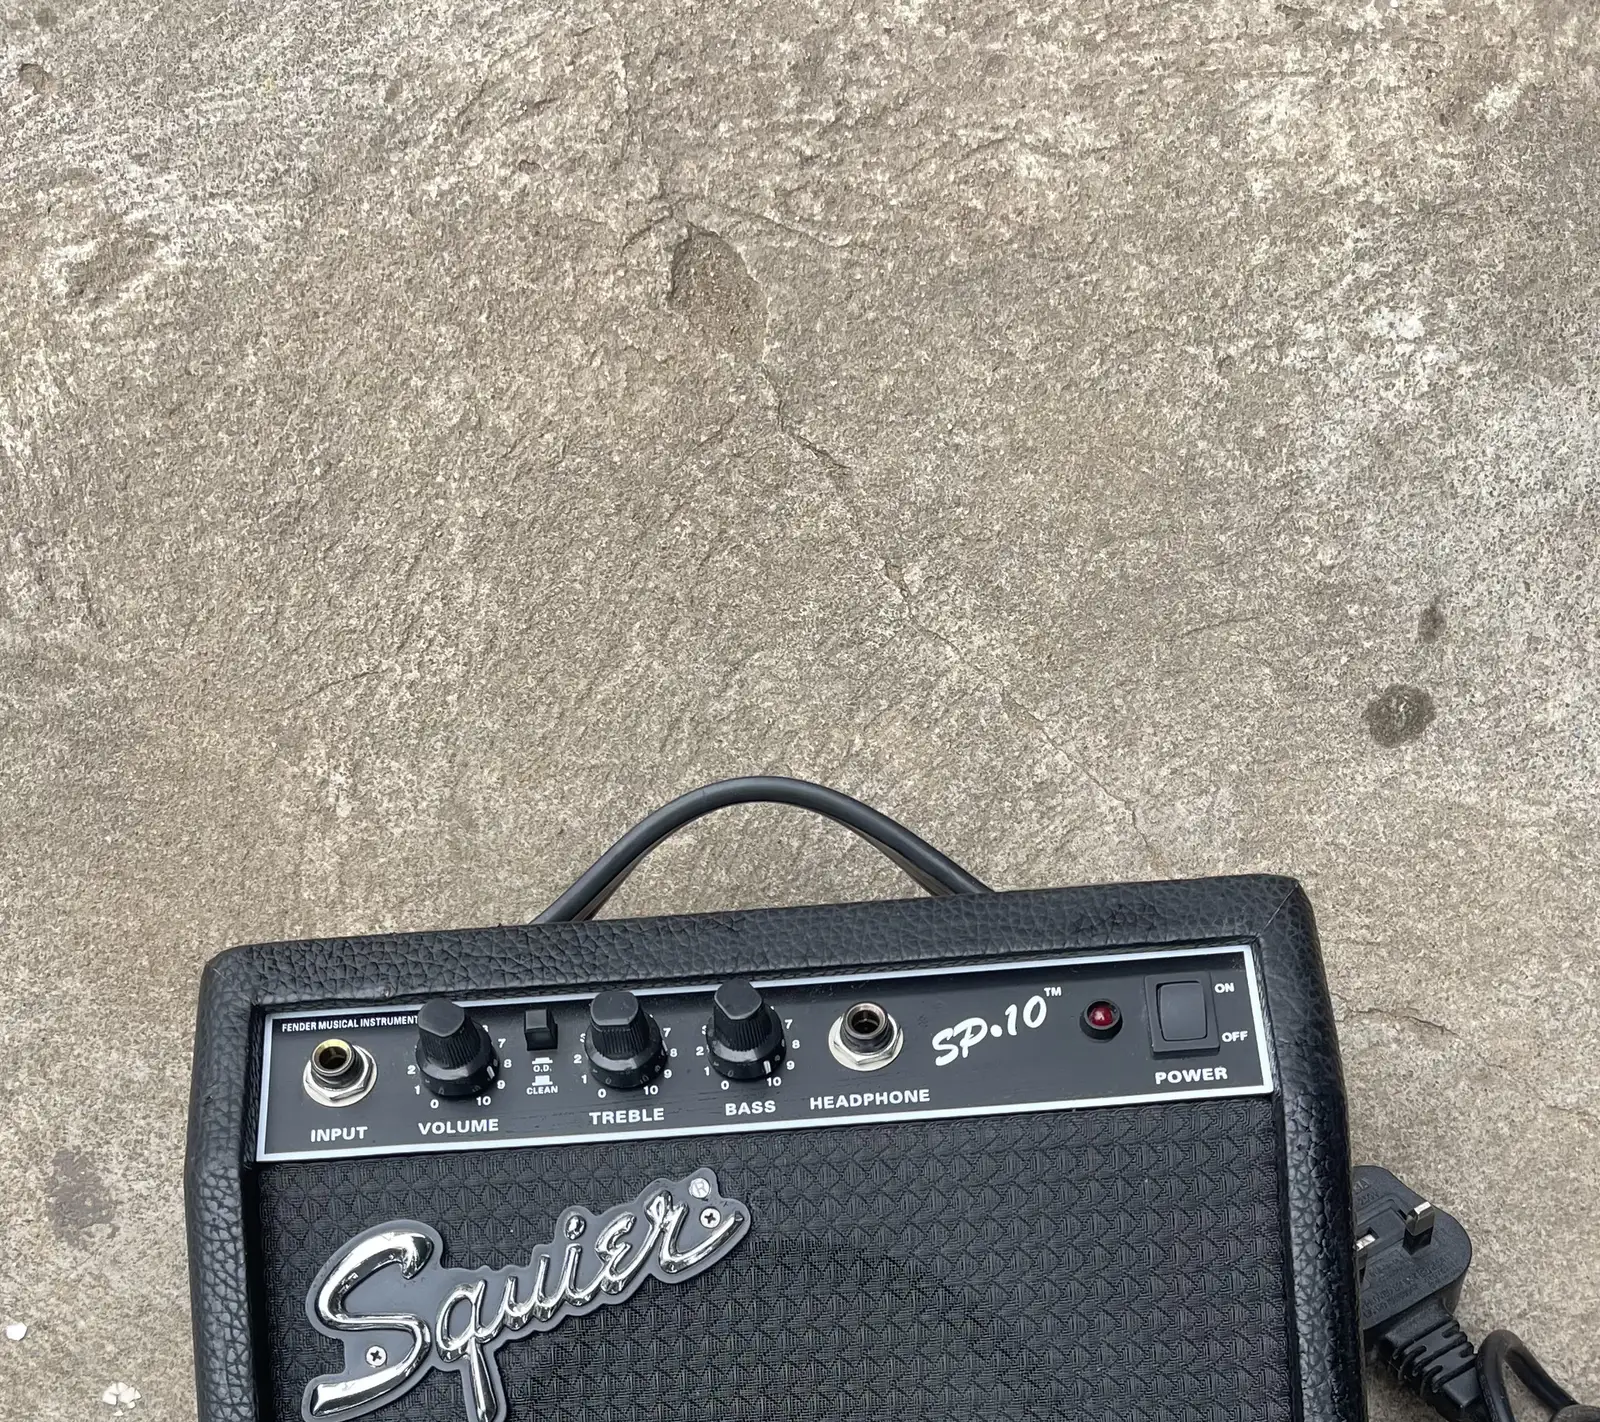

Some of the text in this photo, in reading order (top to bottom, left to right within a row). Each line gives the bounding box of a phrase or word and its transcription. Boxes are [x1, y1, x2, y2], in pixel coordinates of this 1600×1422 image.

[1214, 982, 1235, 994] ON
[281, 1021, 317, 1033] FENDER
[318, 1018, 359, 1030] MUSICAL
[784, 1018, 793, 1030] 7
[662, 1027, 672, 1038] 7
[1221, 1030, 1248, 1043] OFF
[497, 1037, 507, 1049] 7
[791, 1039, 801, 1049] 8
[669, 1047, 678, 1058] 8
[695, 1045, 705, 1057] 2
[503, 1058, 512, 1069] 8
[573, 1053, 582, 1064] 2
[407, 1064, 416, 1075] 2
[703, 1066, 710, 1076] 1
[786, 1060, 795, 1071] 9
[581, 1074, 587, 1084] 1
[663, 1068, 673, 1079] 9
[1154, 1066, 1228, 1085] POWER
[496, 1079, 506, 1090] 9
[720, 1080, 730, 1091] 0
[766, 1076, 782, 1087] 10
[414, 1084, 421, 1095] 1
[526, 1086, 559, 1095] CLEAN
[597, 1088, 607, 1099] 0
[643, 1085, 659, 1096] 10
[429, 1098, 440, 1109] 0
[476, 1095, 492, 1106] 10
[809, 1088, 931, 1110] HEADPHONE
[725, 1099, 776, 1116] BASS
[588, 1107, 665, 1125] TREBLE
[417, 1118, 499, 1135] VOLUME
[310, 1126, 368, 1143] INPUT
